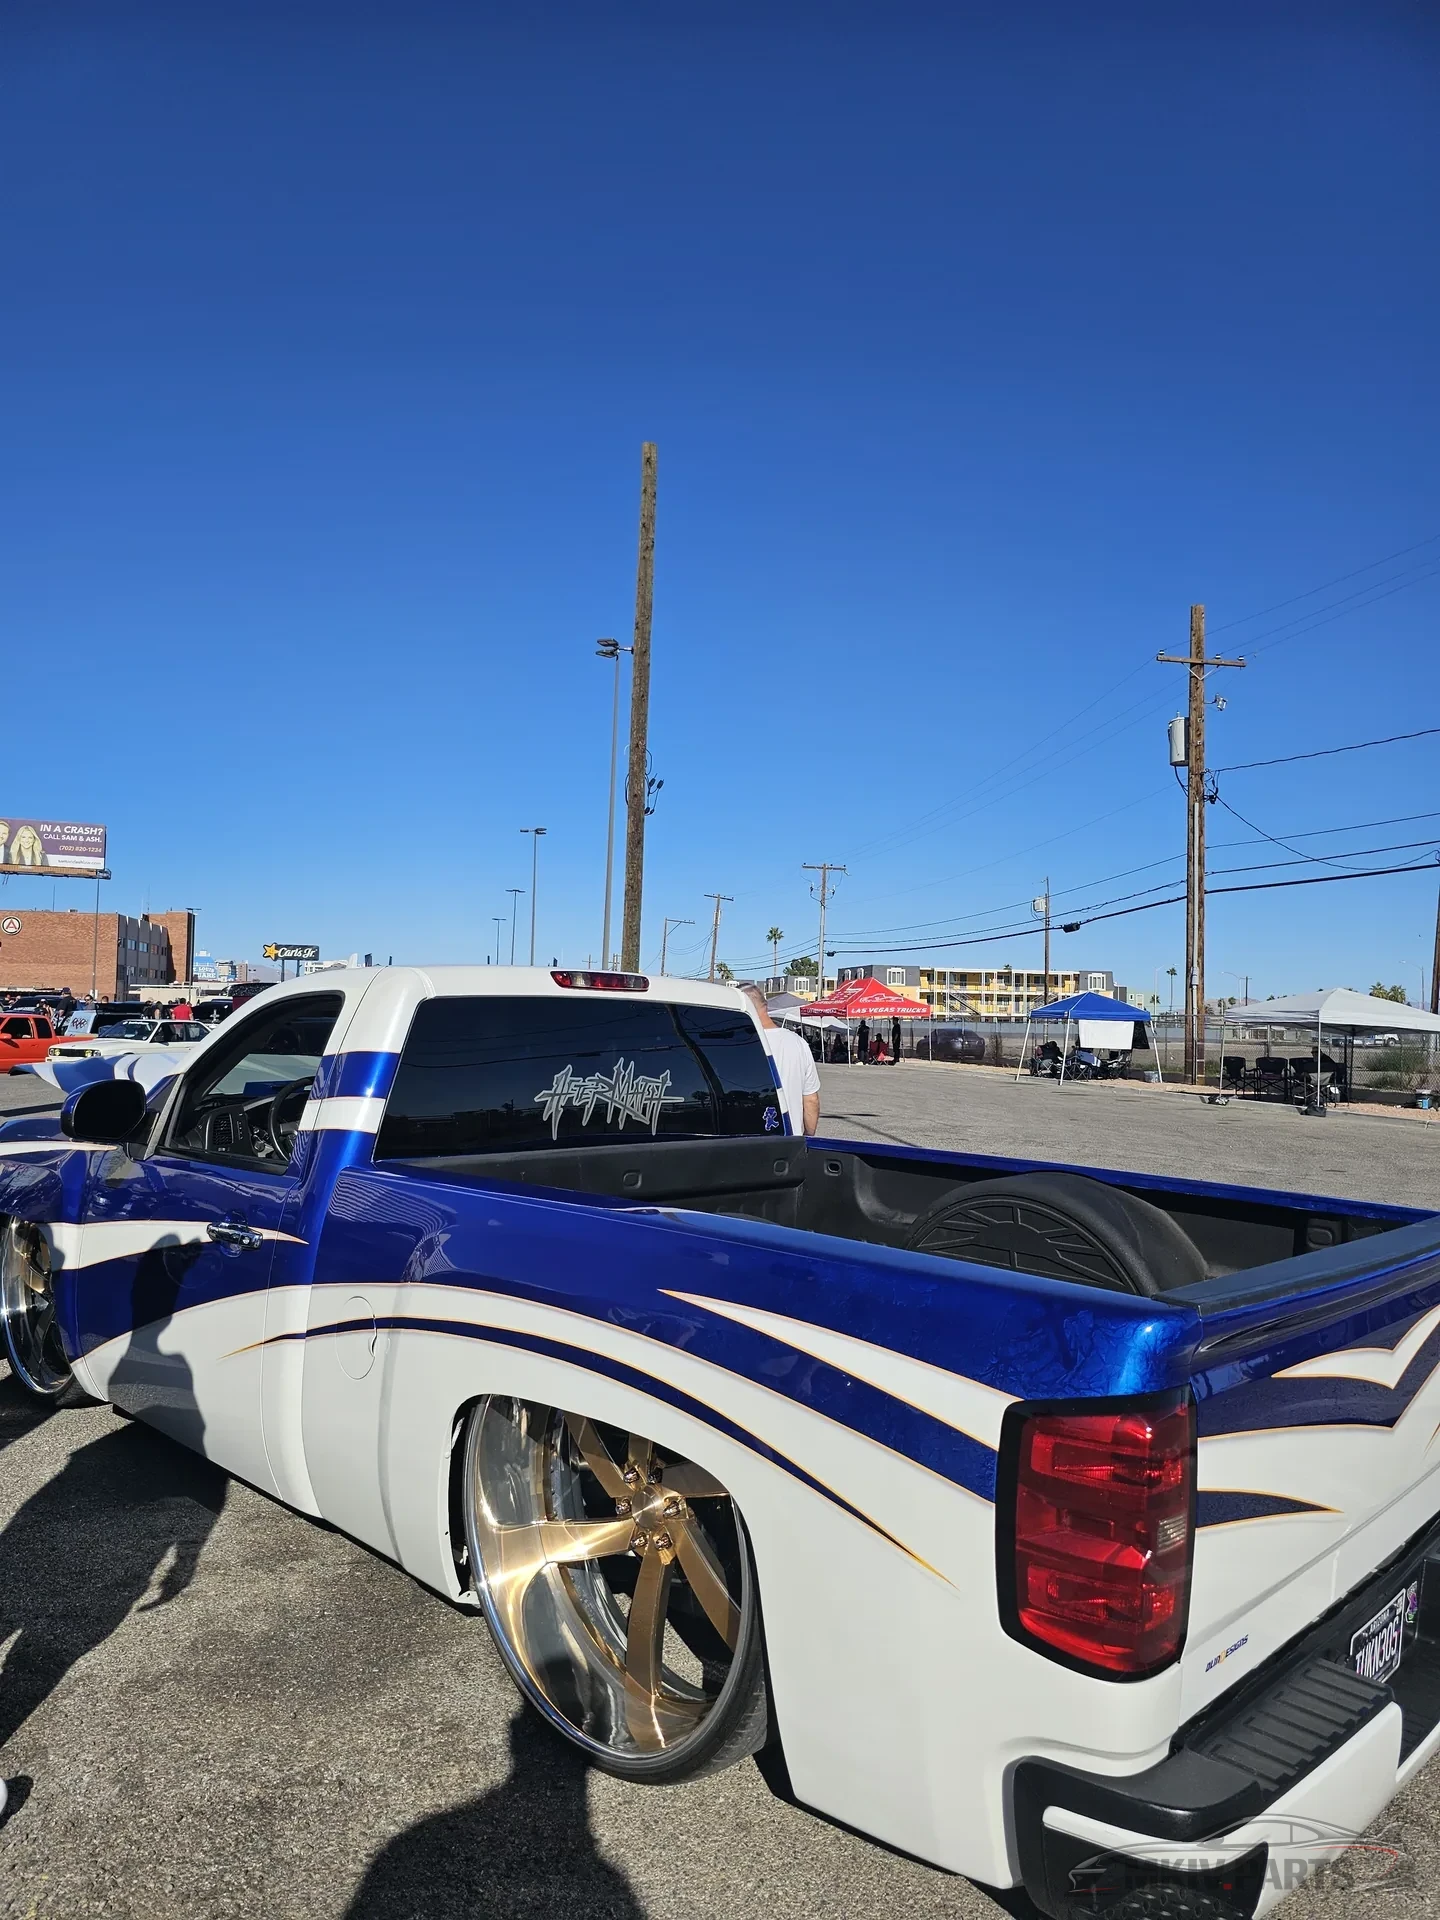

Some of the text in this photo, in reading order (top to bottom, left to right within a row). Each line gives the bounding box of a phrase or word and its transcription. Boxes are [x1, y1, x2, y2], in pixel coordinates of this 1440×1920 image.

[40, 824, 103, 836] IN A CRASH?
[278, 947, 303, 958] Carl's
